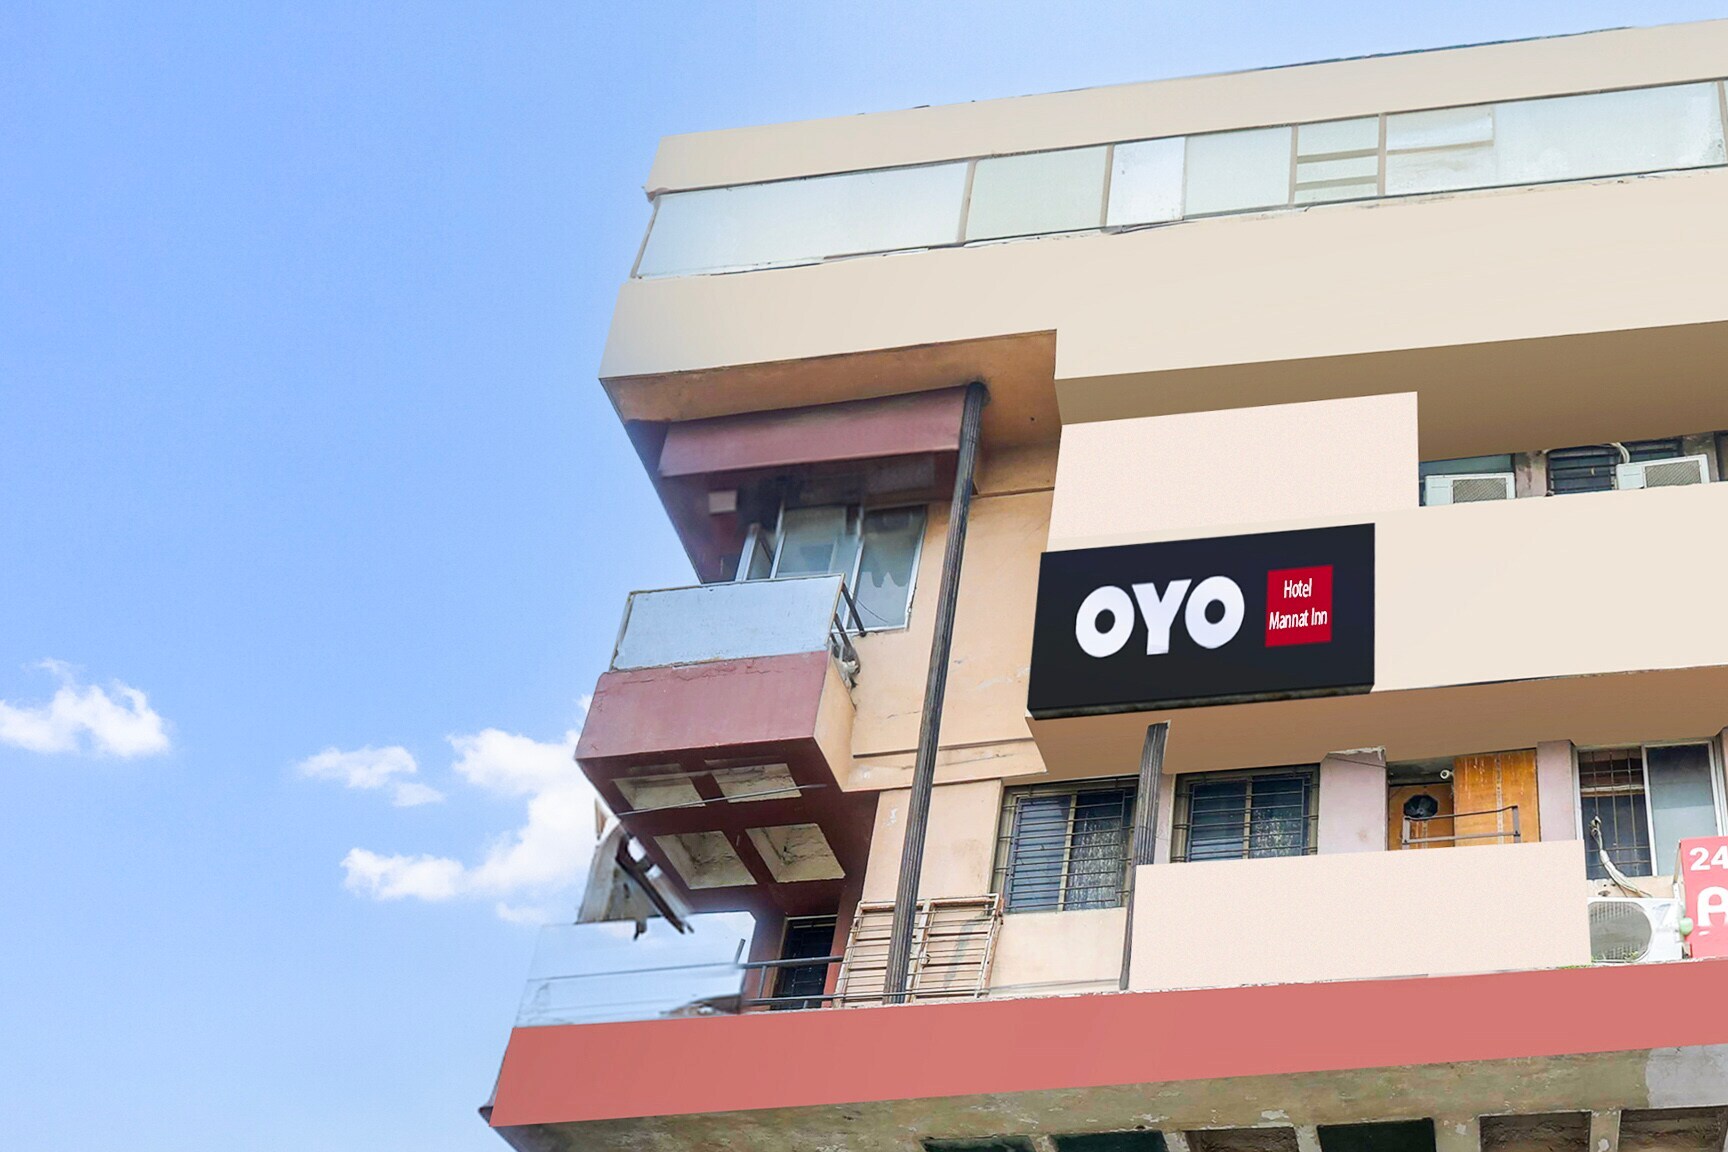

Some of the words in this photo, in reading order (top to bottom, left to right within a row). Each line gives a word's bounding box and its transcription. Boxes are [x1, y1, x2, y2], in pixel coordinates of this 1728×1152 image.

[1283, 577, 1313, 599] Hotel
[1075, 575, 1245, 658] OYO
[1268, 609, 1309, 630] Mannat
[1310, 607, 1328, 626] Inn
